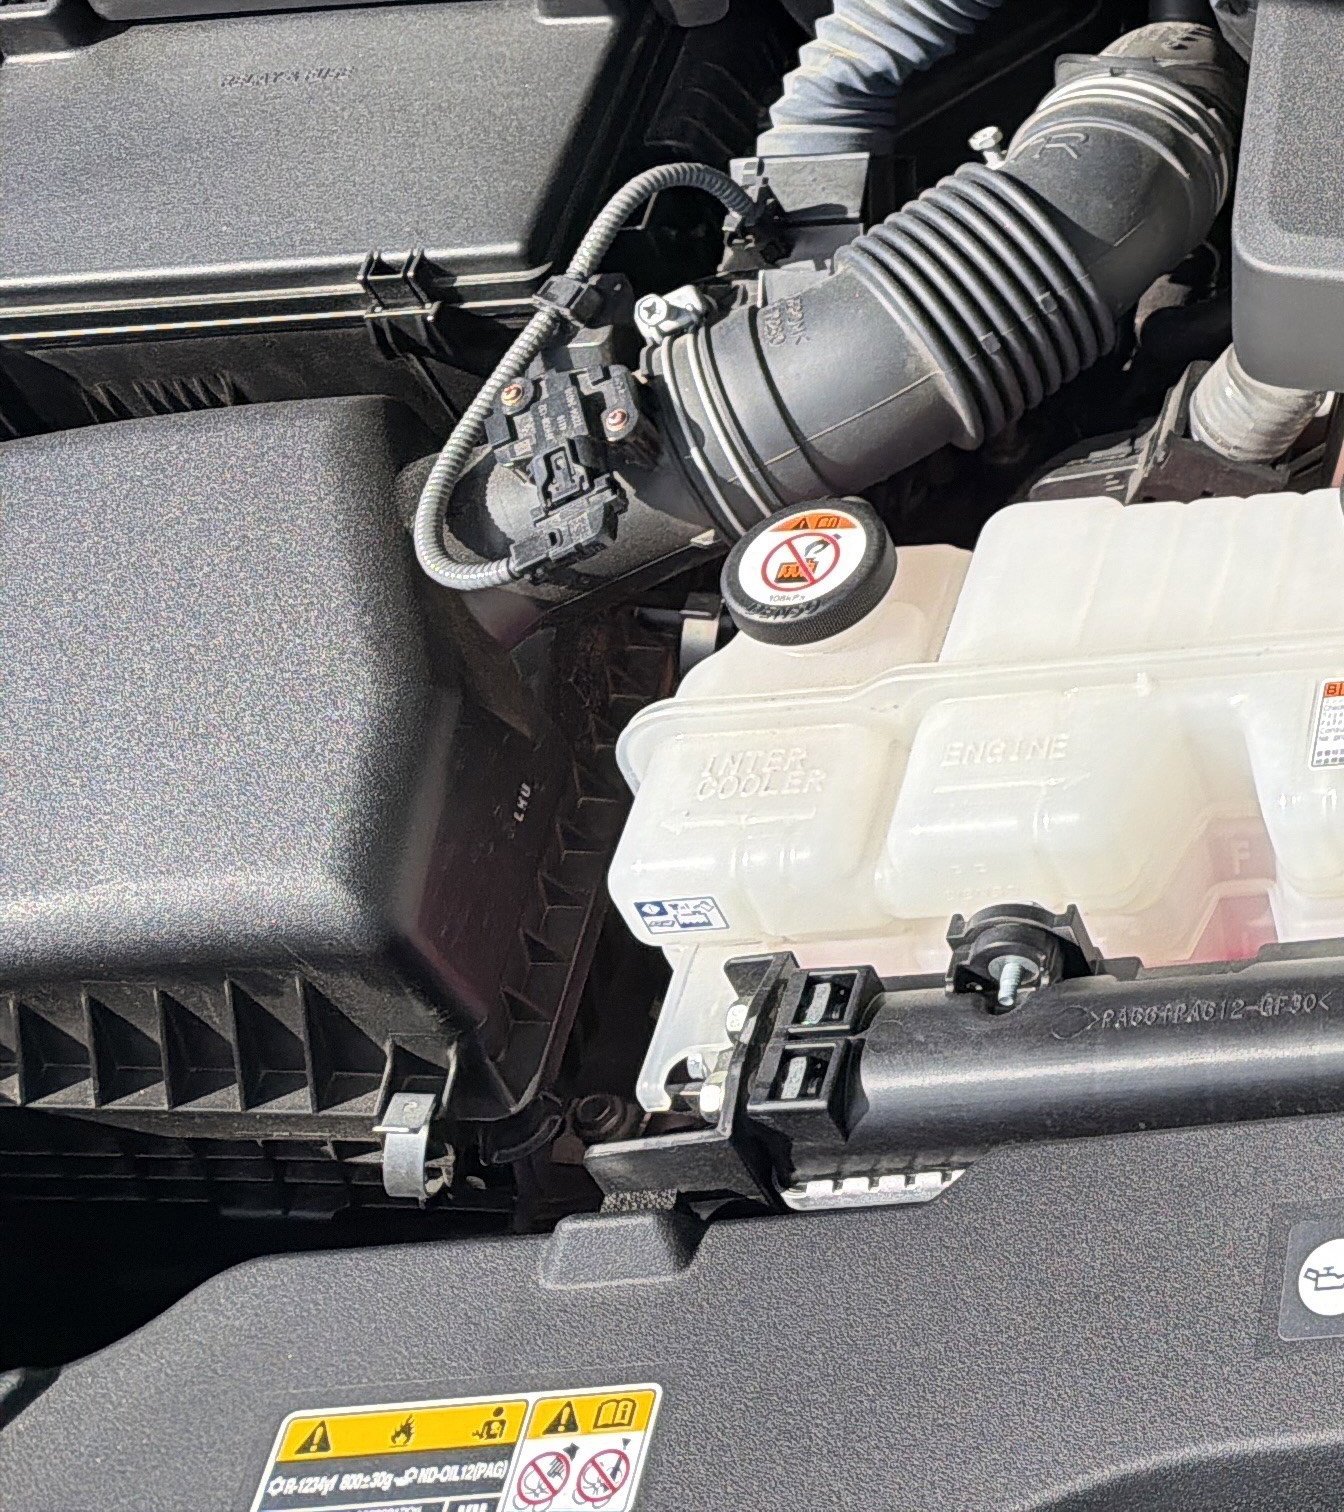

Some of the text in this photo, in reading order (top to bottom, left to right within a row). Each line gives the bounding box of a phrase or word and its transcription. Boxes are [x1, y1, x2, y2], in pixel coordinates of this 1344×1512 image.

[700, 747, 808, 777] INTER
[940, 733, 1070, 768] ENGINE
[697, 769, 828, 802] COOLER
